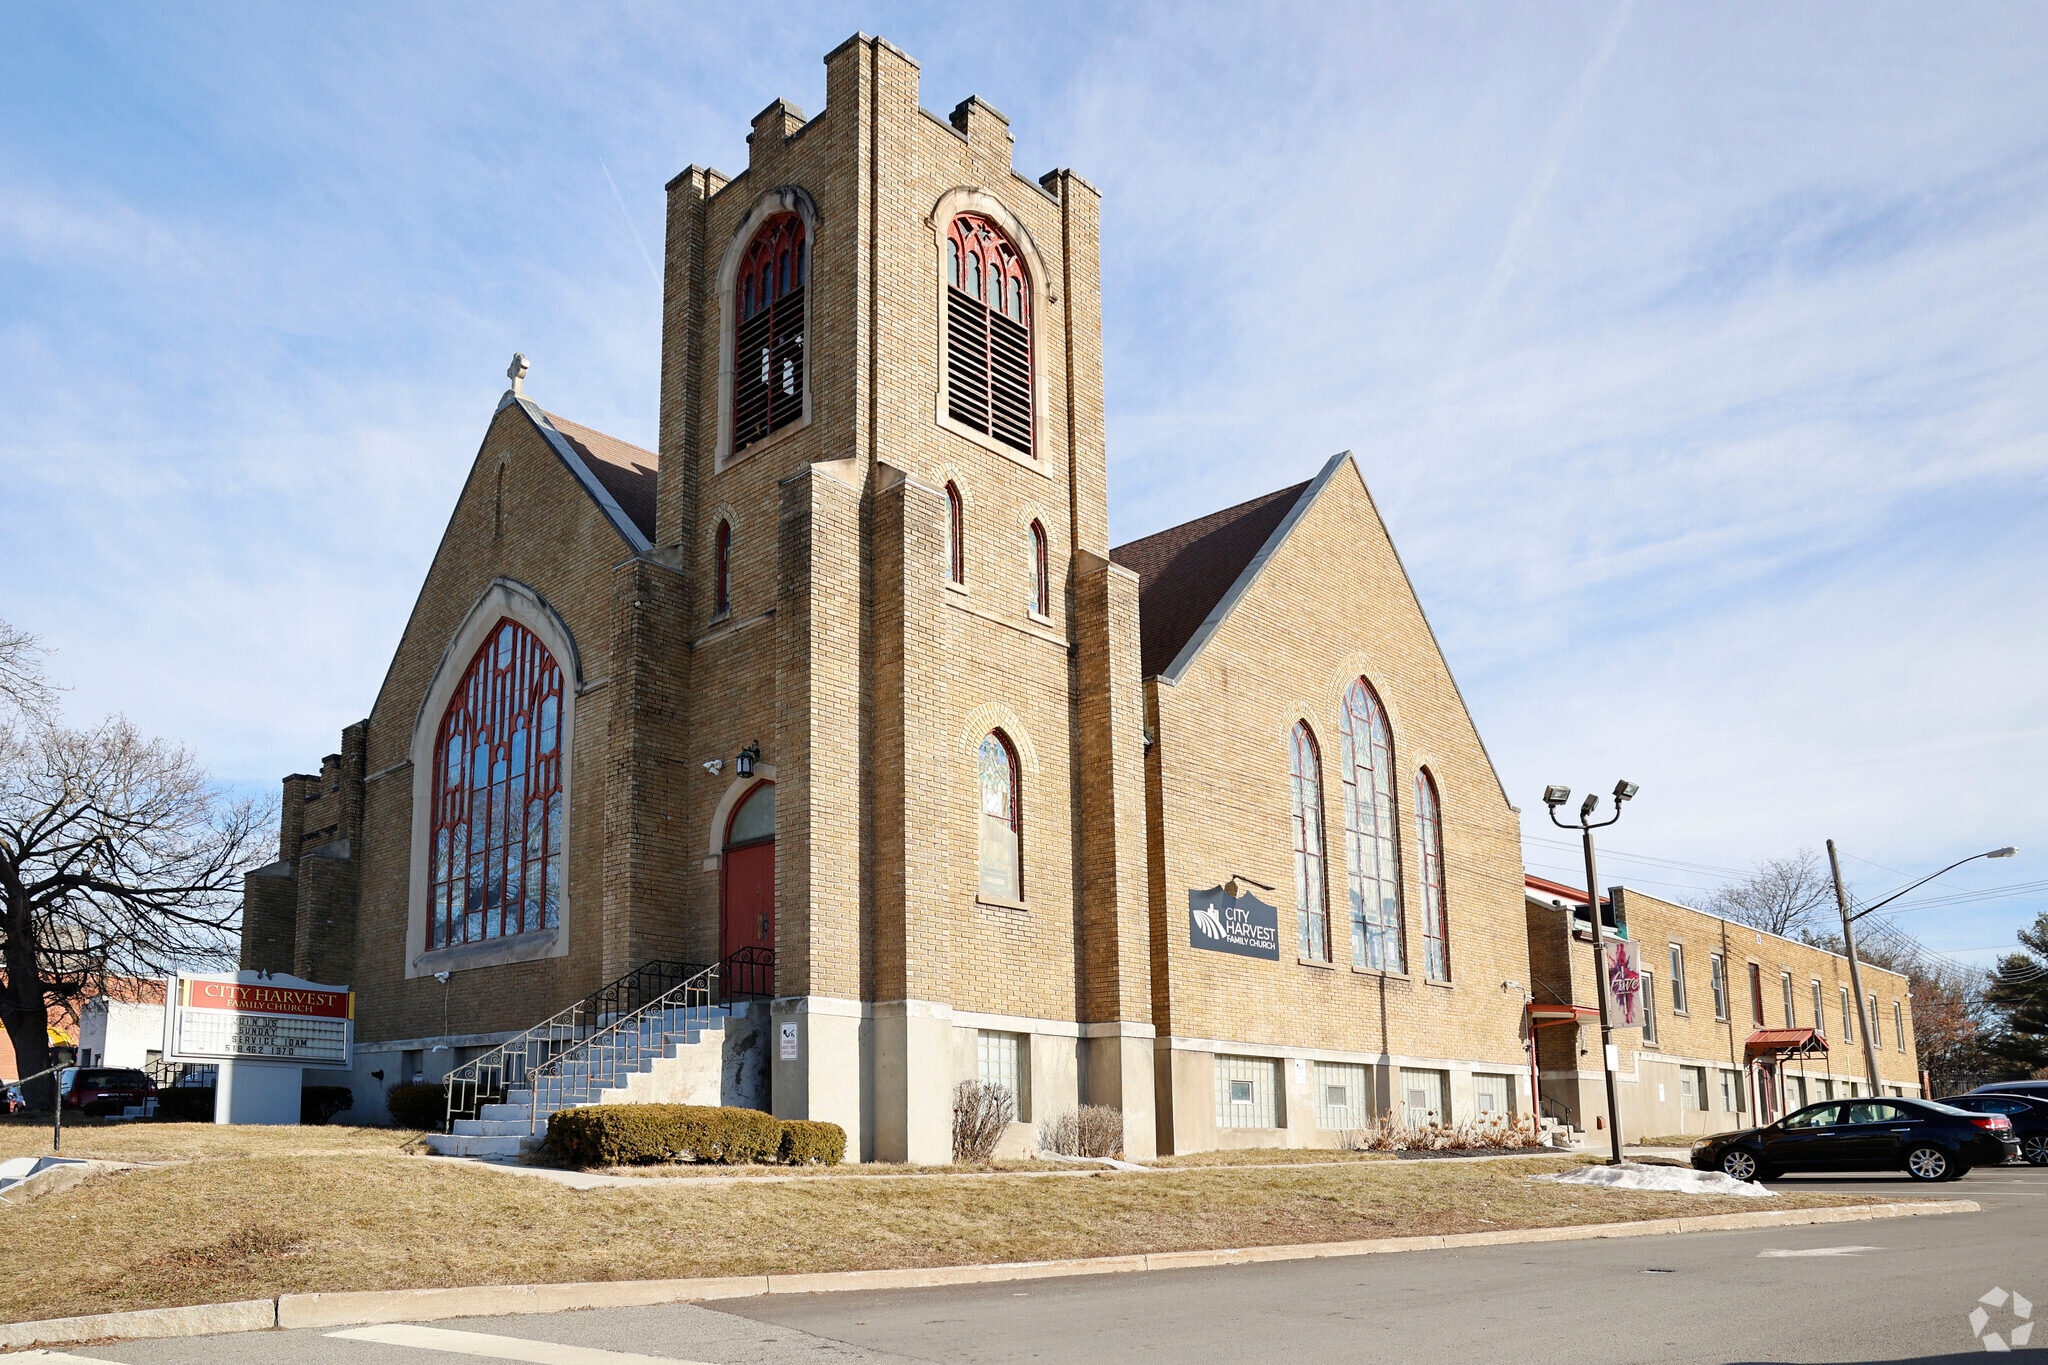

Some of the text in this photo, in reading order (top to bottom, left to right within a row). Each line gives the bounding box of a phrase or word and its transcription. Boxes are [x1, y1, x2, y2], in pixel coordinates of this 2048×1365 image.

[1225, 907, 1249, 923] CITY
[1226, 920, 1275, 941] HARVEST
[1226, 934, 1276, 950] FAMILY CHURCH
[204, 984, 337, 1007] CITY HARVEST
[226, 999, 313, 1013] FAMILY CHURCH
[265, 1019, 277, 1027] US
[239, 1026, 276, 1037] SUNDAY
[232, 1035, 307, 1048] SERVICE 10AM
[246, 1045, 264, 1055] 462
[271, 1046, 294, 1056] 1370
